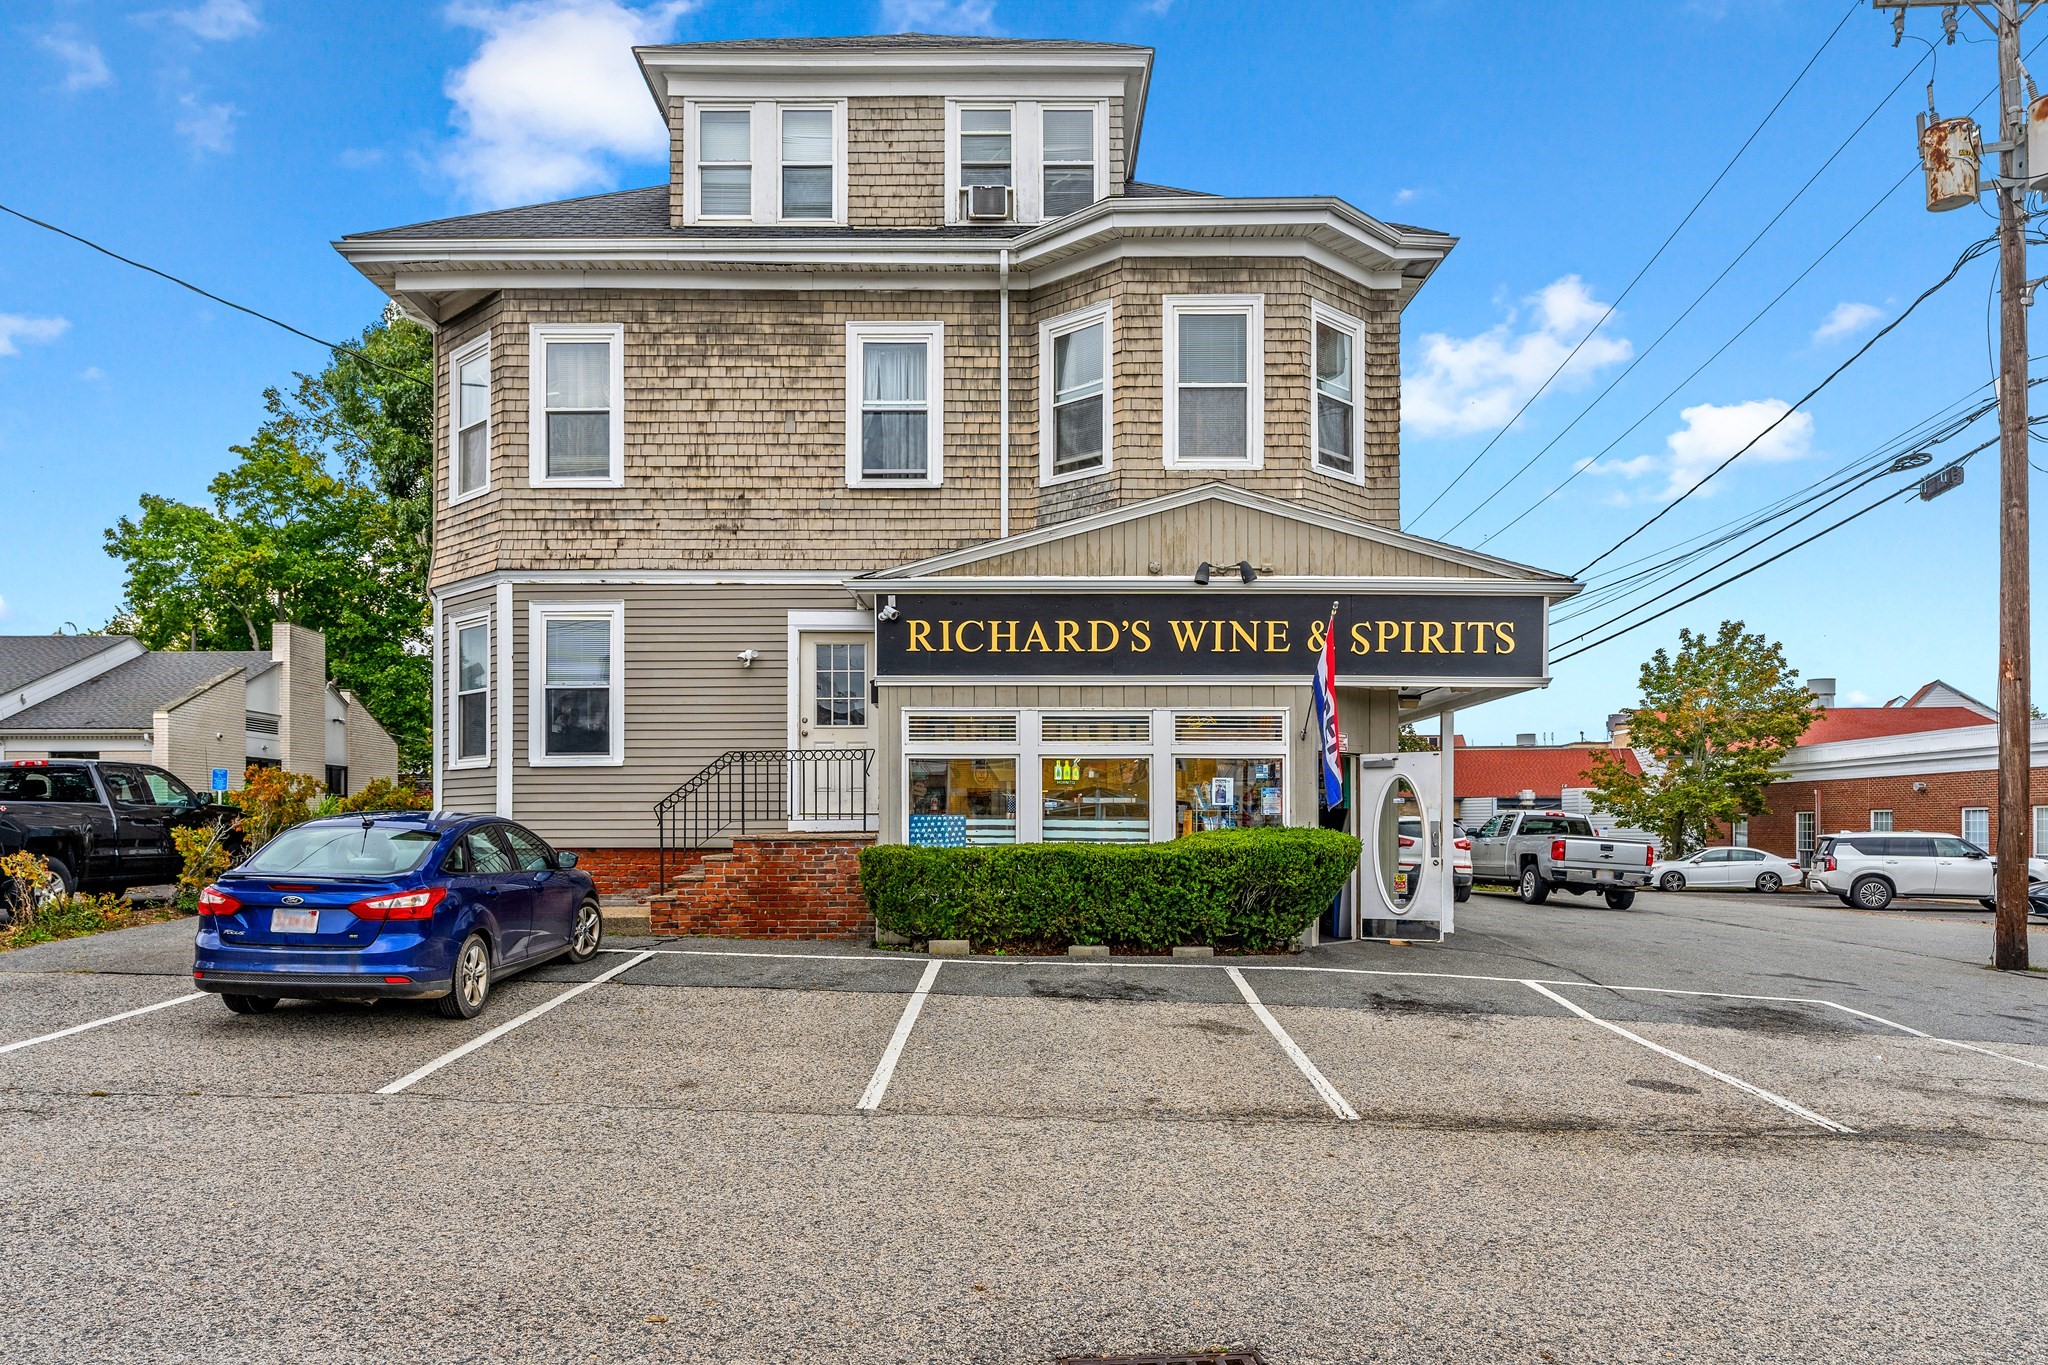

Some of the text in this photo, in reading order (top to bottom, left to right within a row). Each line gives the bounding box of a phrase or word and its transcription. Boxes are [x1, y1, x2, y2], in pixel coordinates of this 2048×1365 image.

[906, 619, 1516, 655] RICHARD'S WINE & SPIRITS
[284, 896, 301, 904] Ford
